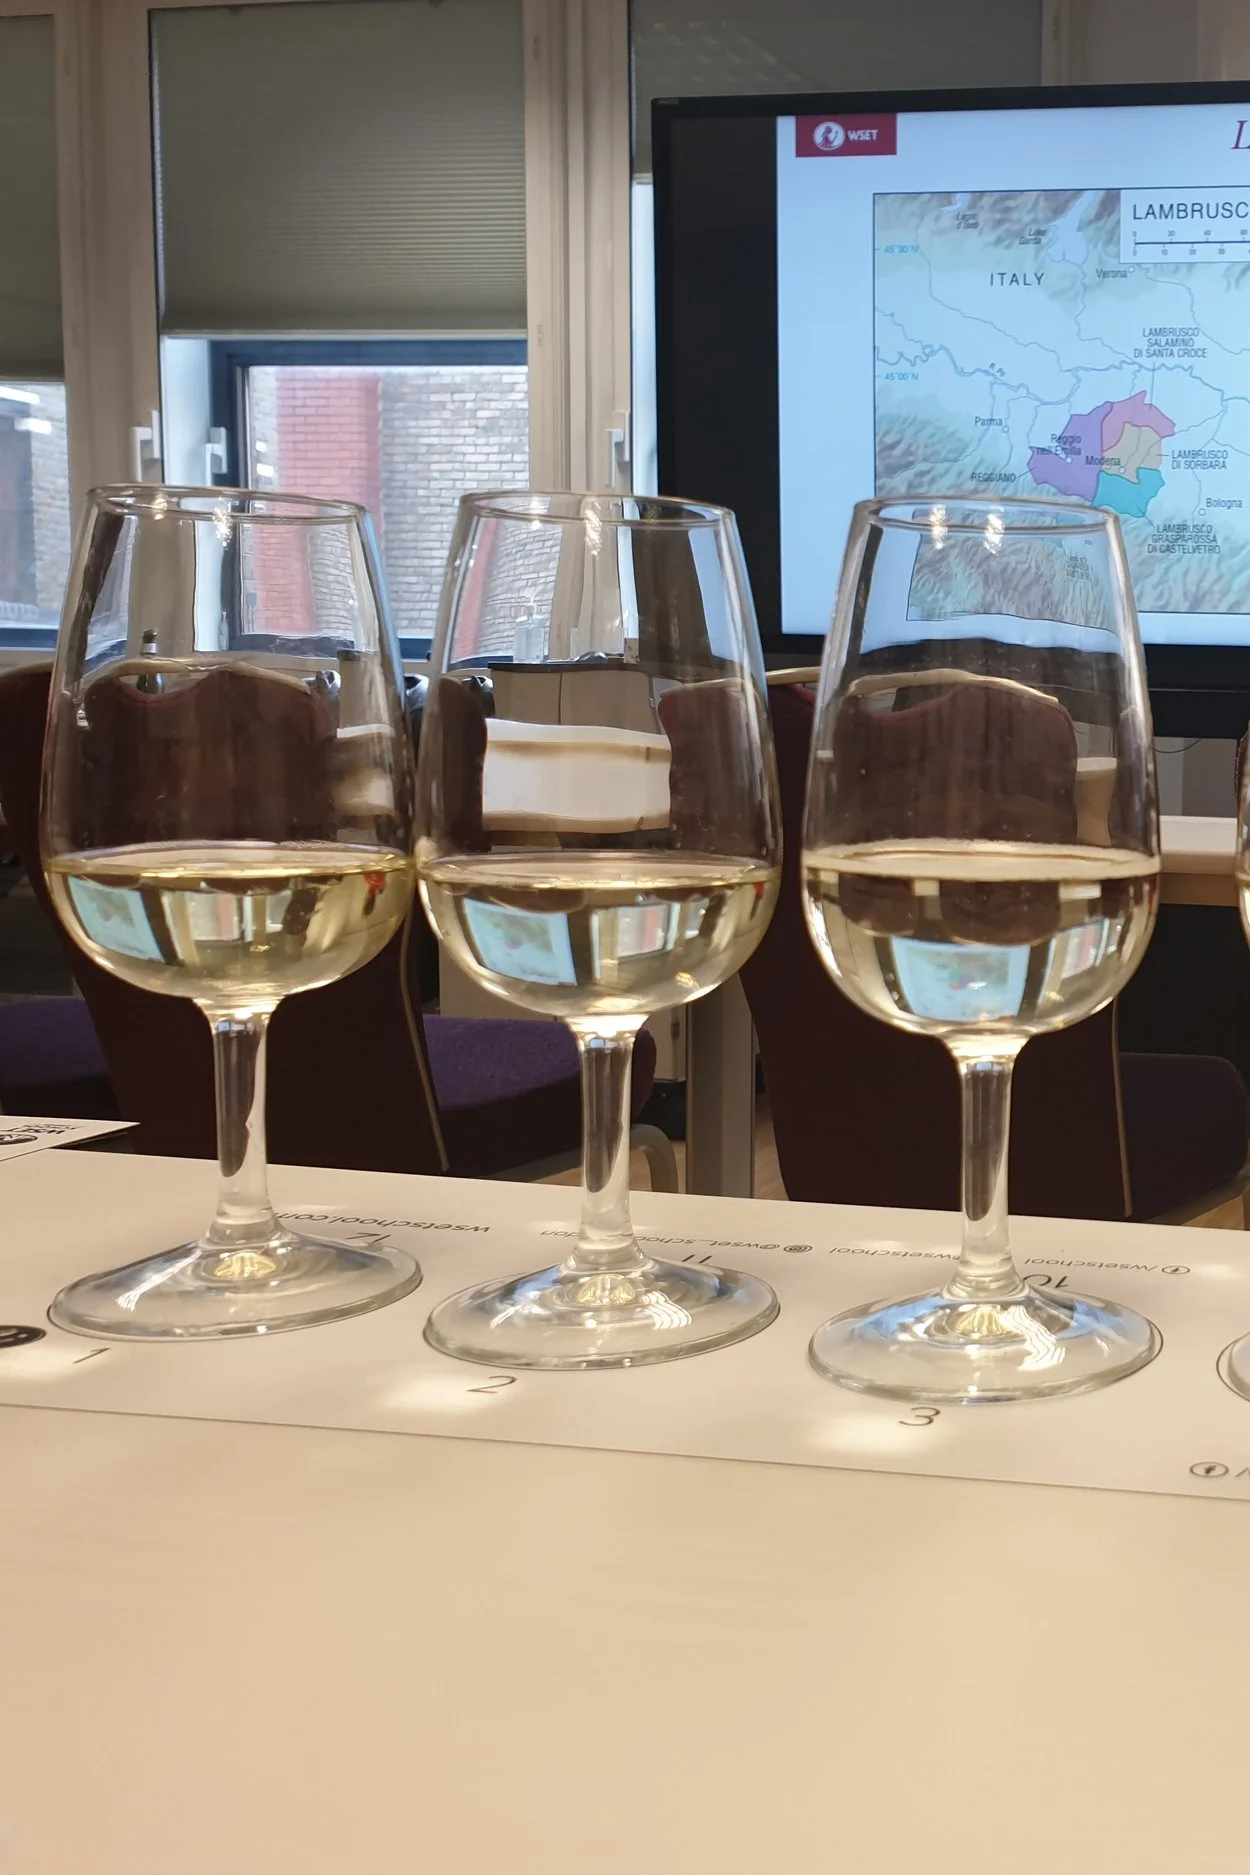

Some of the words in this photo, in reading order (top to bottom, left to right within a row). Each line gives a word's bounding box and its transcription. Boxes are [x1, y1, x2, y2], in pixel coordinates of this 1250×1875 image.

[848, 129, 879, 141] WSET
[990, 272, 1045, 286] ITALY
[1096, 268, 1128, 279] Verona
[1142, 327, 1200, 338] LAMBRUSCO
[1147, 338, 1195, 348] SALAMINO
[1134, 349, 1144, 358] DI
[1145, 348, 1175, 358] SANTA
[1177, 348, 1207, 358] CROCE
[974, 416, 1003, 426] Parma
[1050, 433, 1082, 445] Reggio
[1171, 450, 1229, 460] LAMBRUSCO
[1085, 456, 1121, 466] Modena
[1171, 460, 1182, 470] DI
[1183, 460, 1227, 470] SORBARA
[970, 472, 1016, 483] REGGIANO
[1205, 497, 1243, 509] Bologna
[1156, 524, 1213, 534] LAMBRUSCO
[1151, 534, 1218, 543] GRASPAROSSA
[1147, 544, 1158, 554] DI
[1159, 544, 1221, 554] CASTELVETRO
[73, 1346, 112, 1364] 1
[467, 1374, 518, 1394] 2
[897, 1406, 942, 1427] 3
